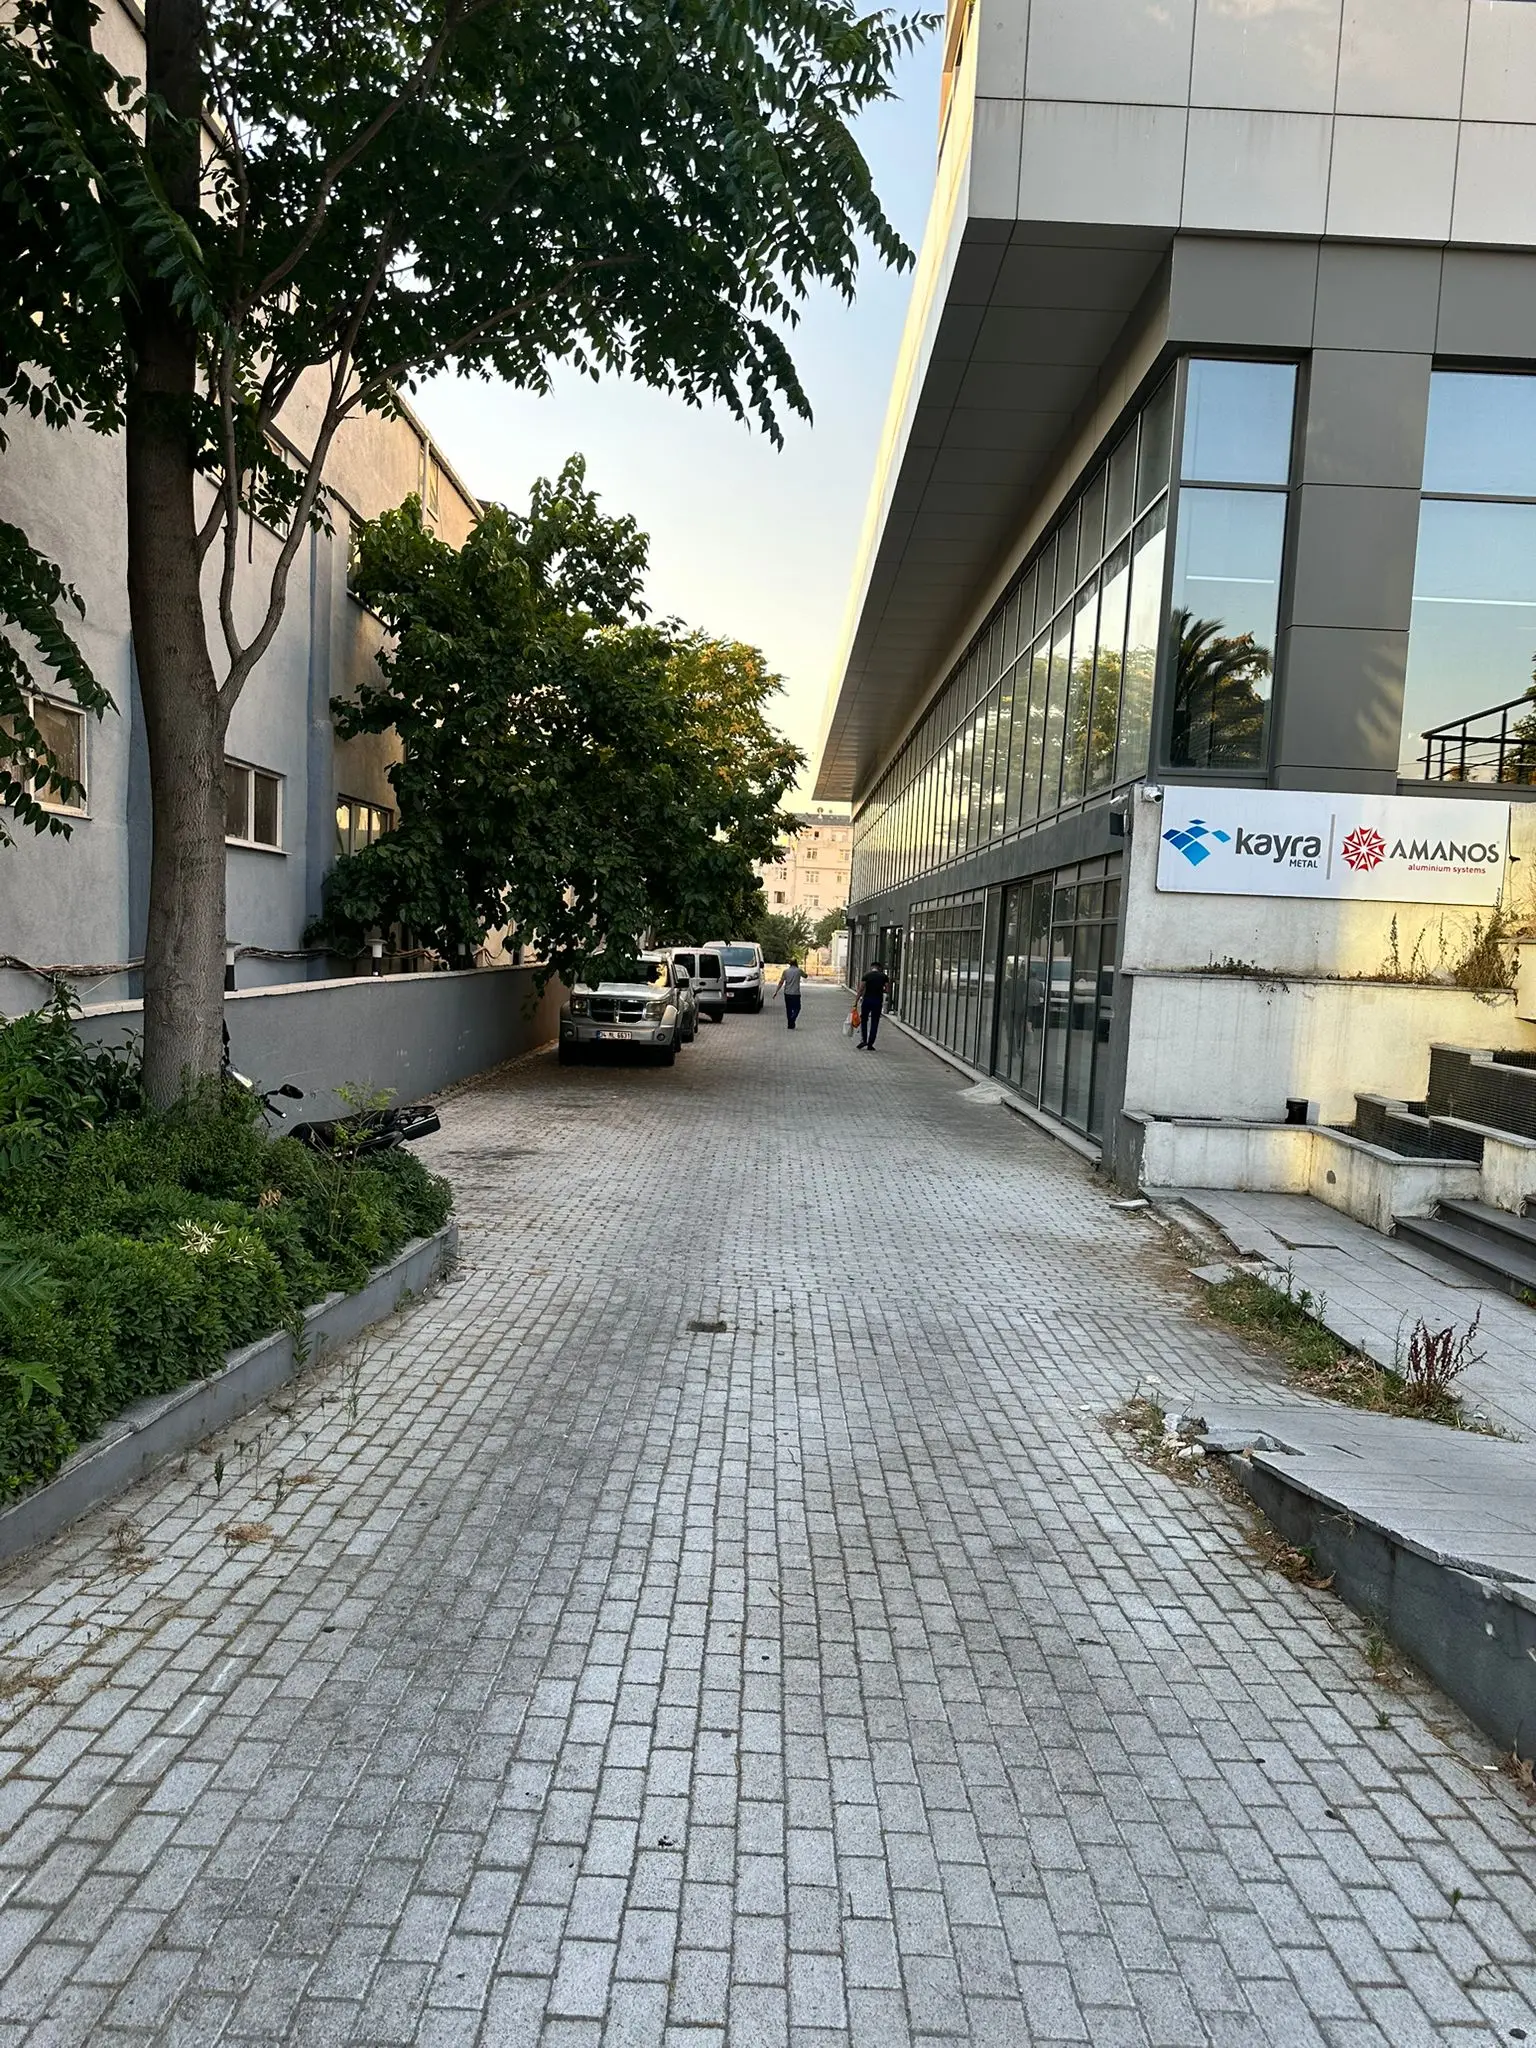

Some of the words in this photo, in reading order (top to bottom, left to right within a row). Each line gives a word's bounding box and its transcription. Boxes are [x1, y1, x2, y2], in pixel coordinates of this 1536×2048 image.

[1235, 827, 1321, 862] kayra
[1389, 839, 1499, 863] AMANOS
[1289, 859, 1318, 869] METAL
[1407, 863, 1451, 873] aluminium
[1452, 866, 1486, 875] systems
